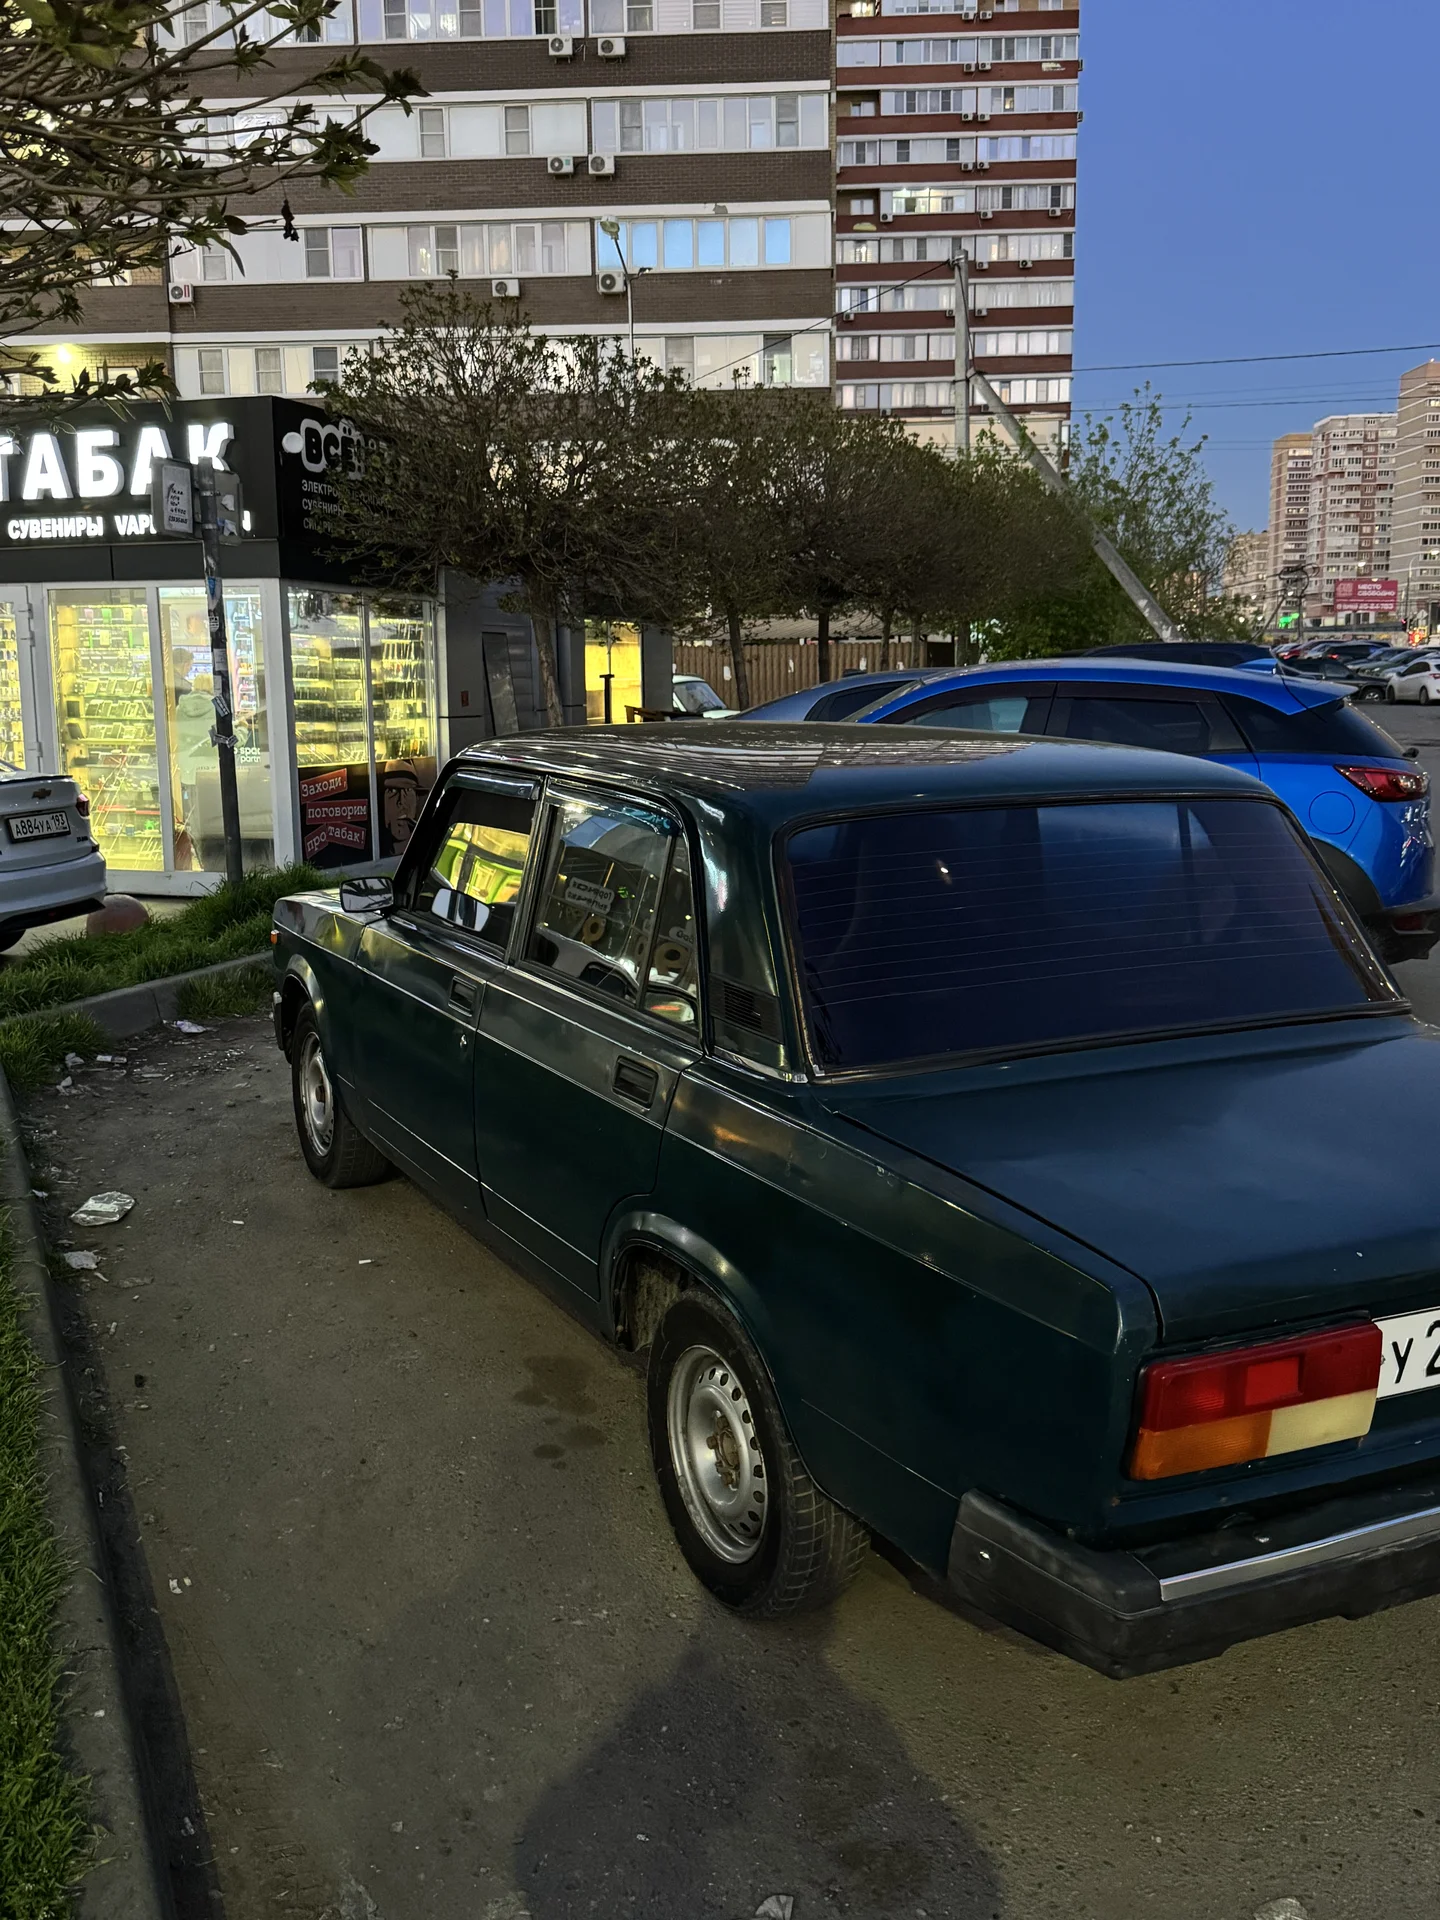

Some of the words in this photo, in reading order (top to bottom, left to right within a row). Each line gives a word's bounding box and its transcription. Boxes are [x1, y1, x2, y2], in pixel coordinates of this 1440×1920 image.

[8, 513, 104, 540] СУВЕНИРЫ
[301, 776, 347, 797] Заходи,
[308, 805, 366, 819] поговорим
[15, 818, 52, 837] А884УА
[51, 813, 66, 827] 193
[306, 831, 327, 852] про
[327, 826, 365, 844] табак!
